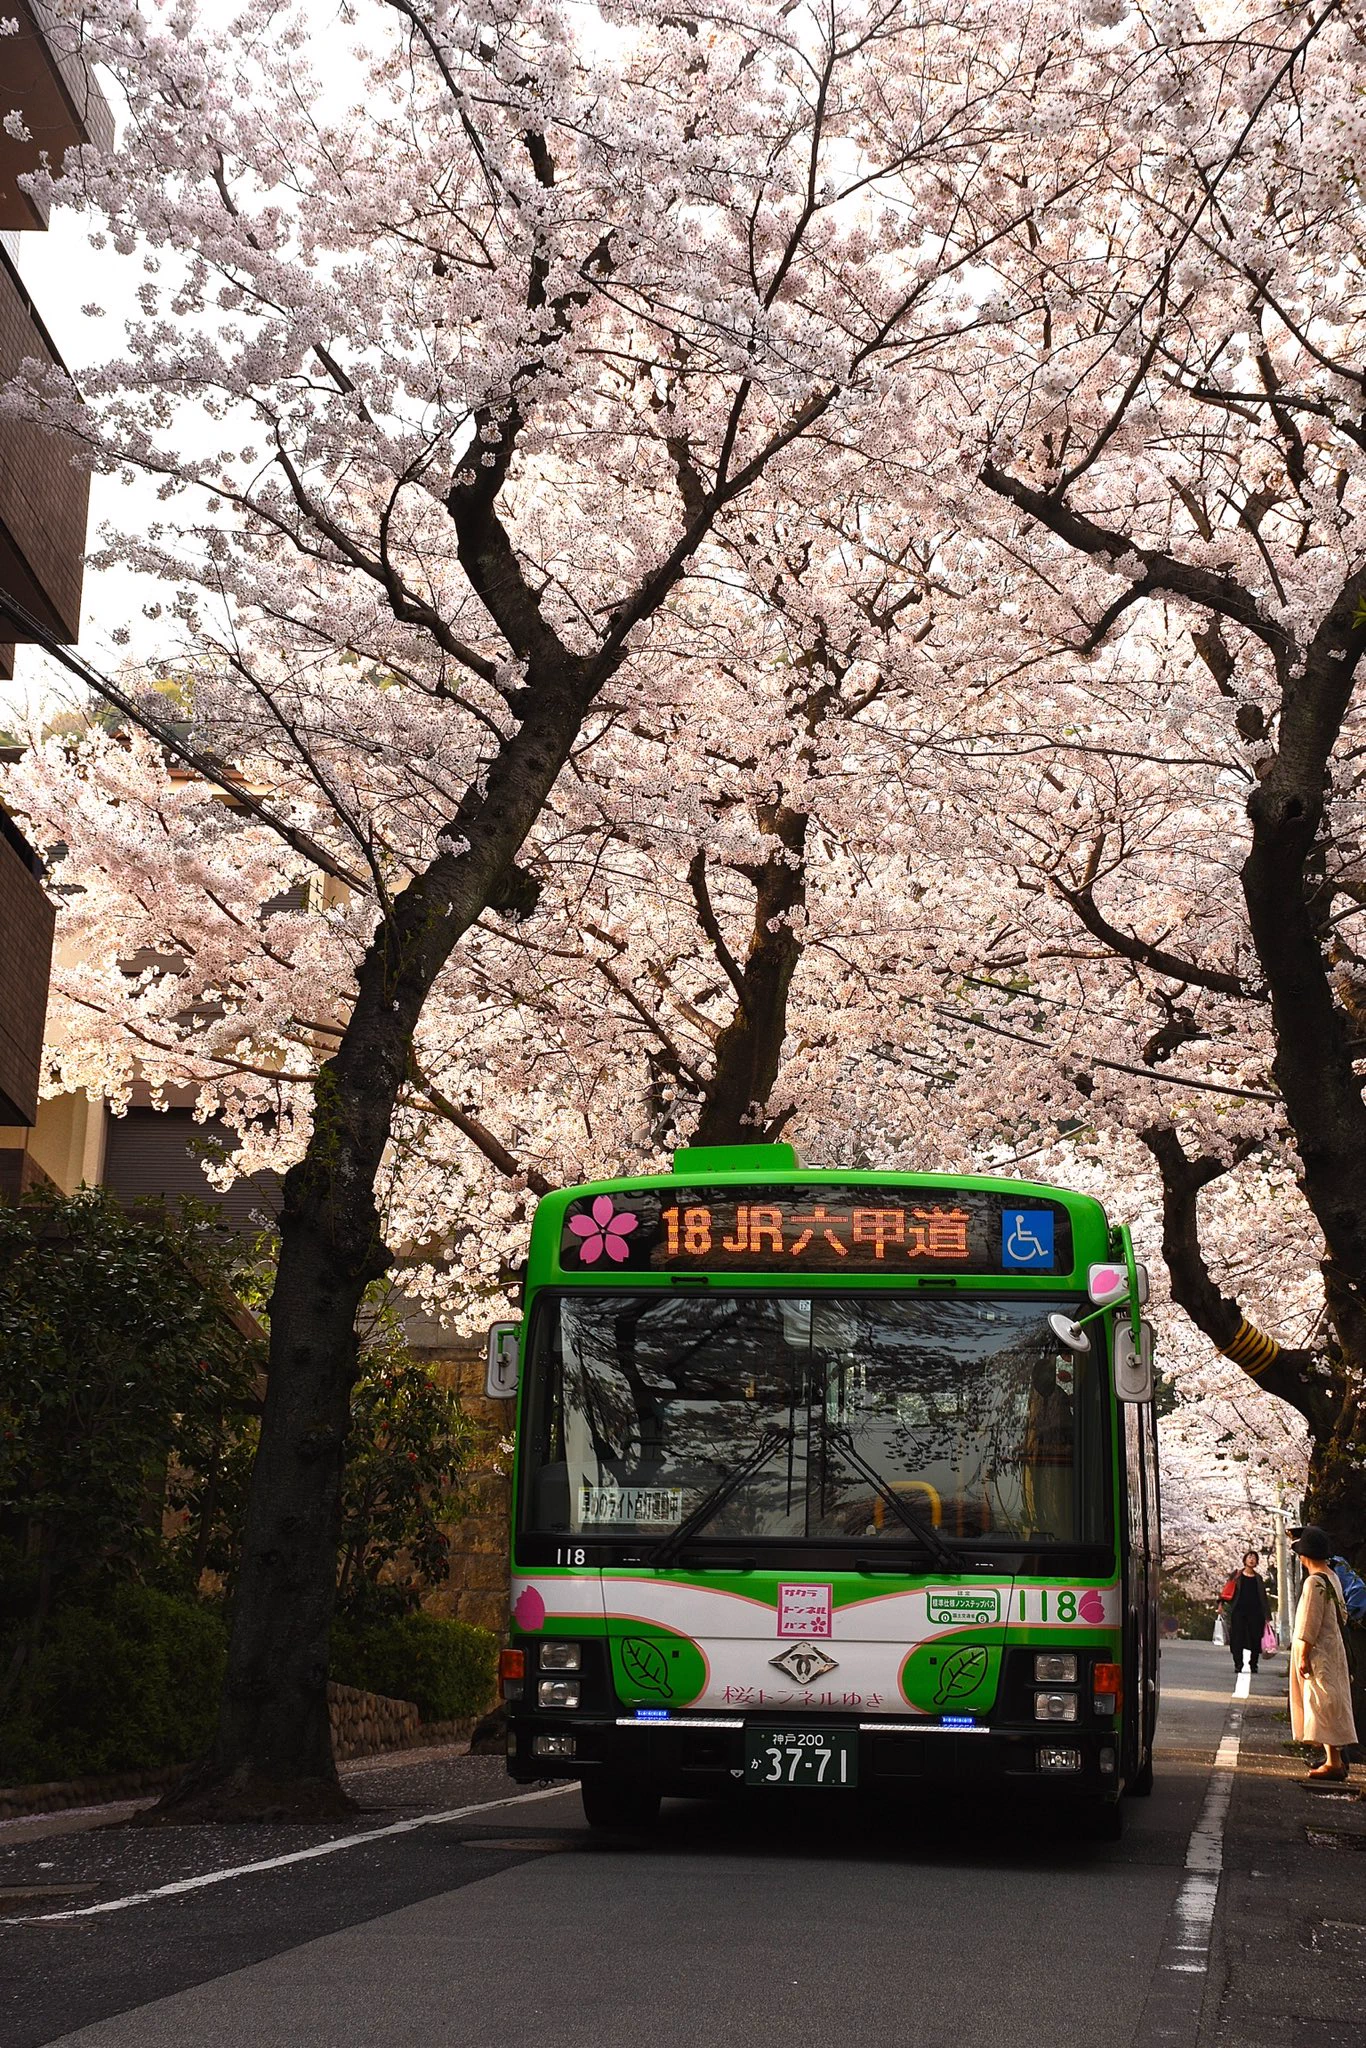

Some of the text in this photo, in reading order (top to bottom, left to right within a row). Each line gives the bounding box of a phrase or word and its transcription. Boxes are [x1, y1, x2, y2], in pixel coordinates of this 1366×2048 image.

[662, 1206, 969, 1258] 18 JR六甲道
[557, 1548, 585, 1565] 118
[784, 1606, 827, 1614] トンネル
[1019, 1589, 1077, 1623] 118
[721, 1685, 884, 1708] 桜トンネルゆき
[750, 1747, 847, 1783] か 37-71
